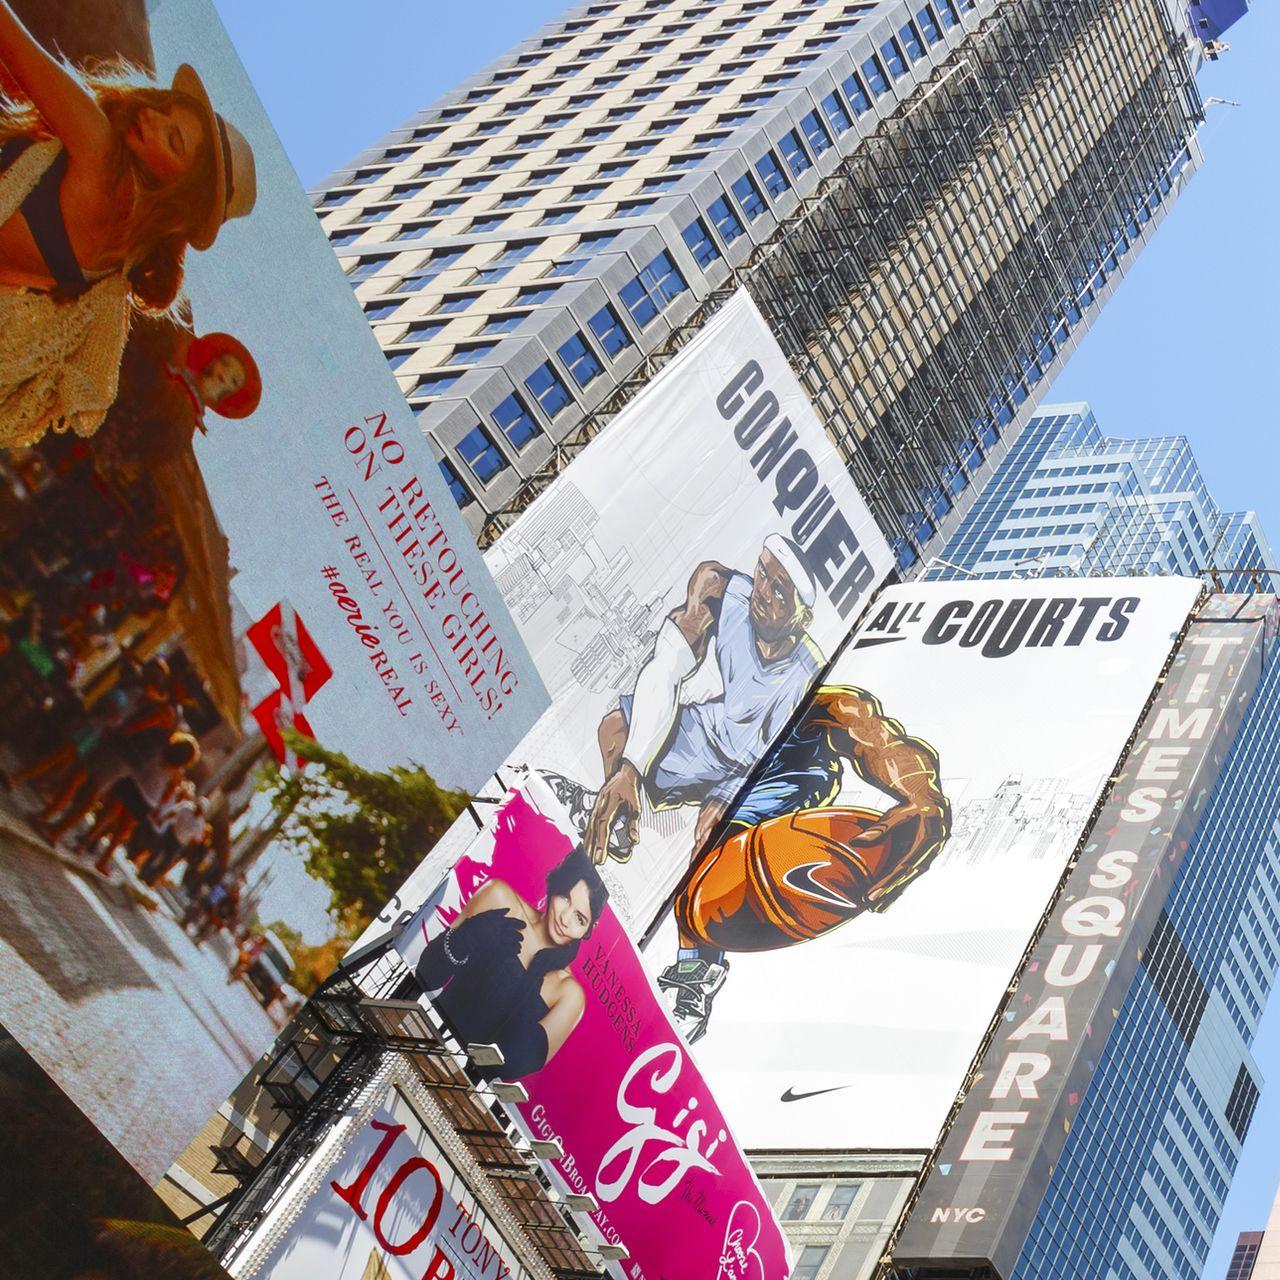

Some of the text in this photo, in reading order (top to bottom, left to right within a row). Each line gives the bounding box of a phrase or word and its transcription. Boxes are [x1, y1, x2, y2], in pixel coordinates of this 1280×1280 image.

[365, 411, 519, 696] NO RETOUCHING
[716, 359, 875, 620] CONQUER
[313, 476, 348, 528] THE
[345, 537, 384, 597] REAL
[382, 600, 413, 646] YOU
[409, 655, 428, 675] IS
[344, 425, 503, 720] ON THESE GIRLS!
[867, 598, 1140, 658] ALL COURTS
[959, 636, 1243, 1162] TIMES SQUARE
[582, 962, 635, 1054] HUDGENS
[595, 945, 642, 1036] VANESSA
[331, 1119, 443, 1256] 10
[595, 1042, 726, 1204] Gigi
[930, 1207, 986, 1224] NYC
